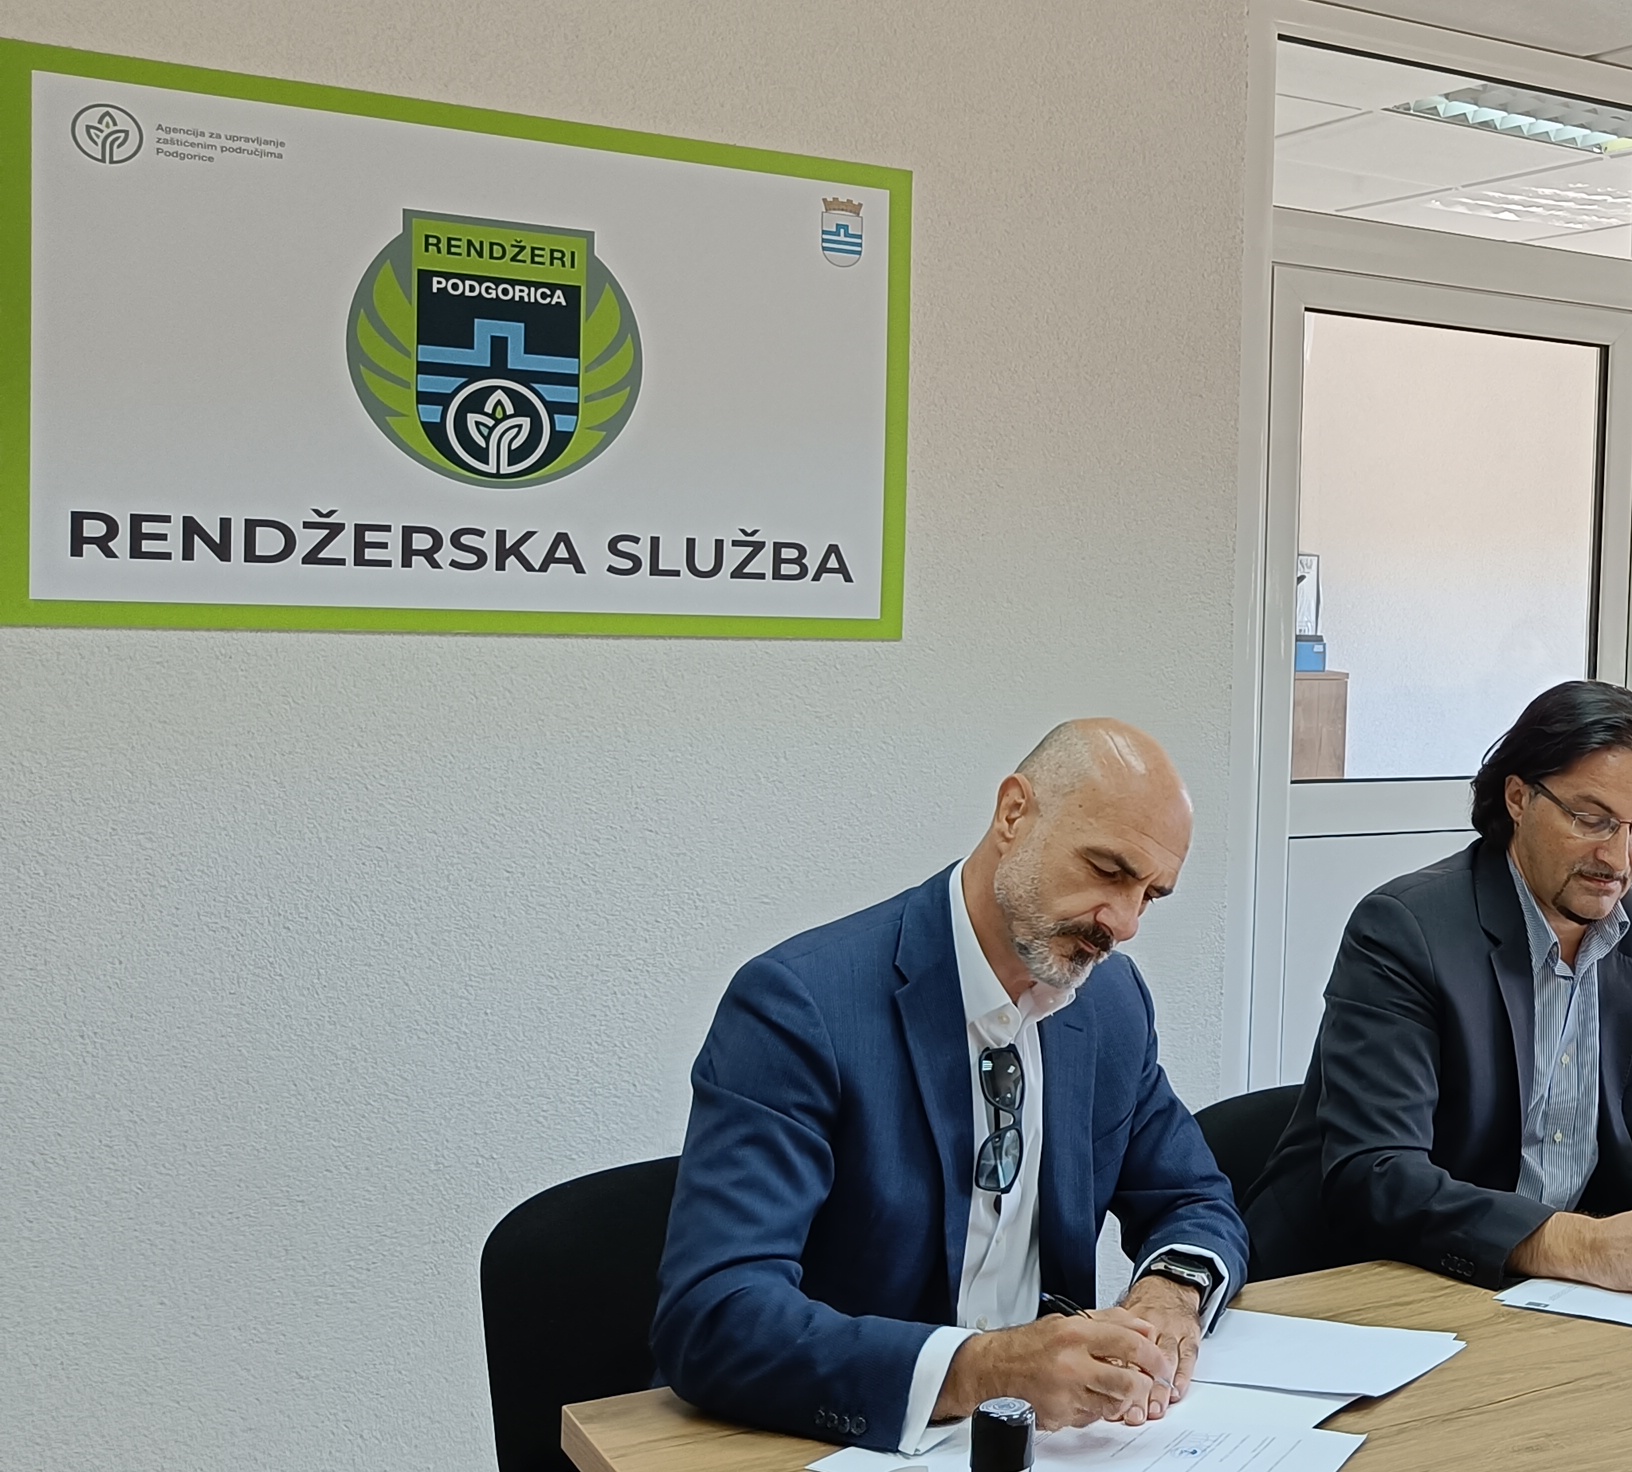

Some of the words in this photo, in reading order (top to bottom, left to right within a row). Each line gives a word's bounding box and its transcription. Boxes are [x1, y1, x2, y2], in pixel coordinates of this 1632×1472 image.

[155, 123, 206, 138] Agencija
[208, 131, 222, 140] za
[224, 133, 286, 149] upravljanje
[155, 136, 218, 151] zaštićenim
[219, 144, 284, 160] područjima
[155, 147, 215, 163] Podgorice
[423, 233, 578, 270] RENDŽERI
[431, 276, 567, 306] PODGORICA
[68, 508, 587, 574] RENDŽERSKA
[605, 528, 854, 583] SLUŽBA
